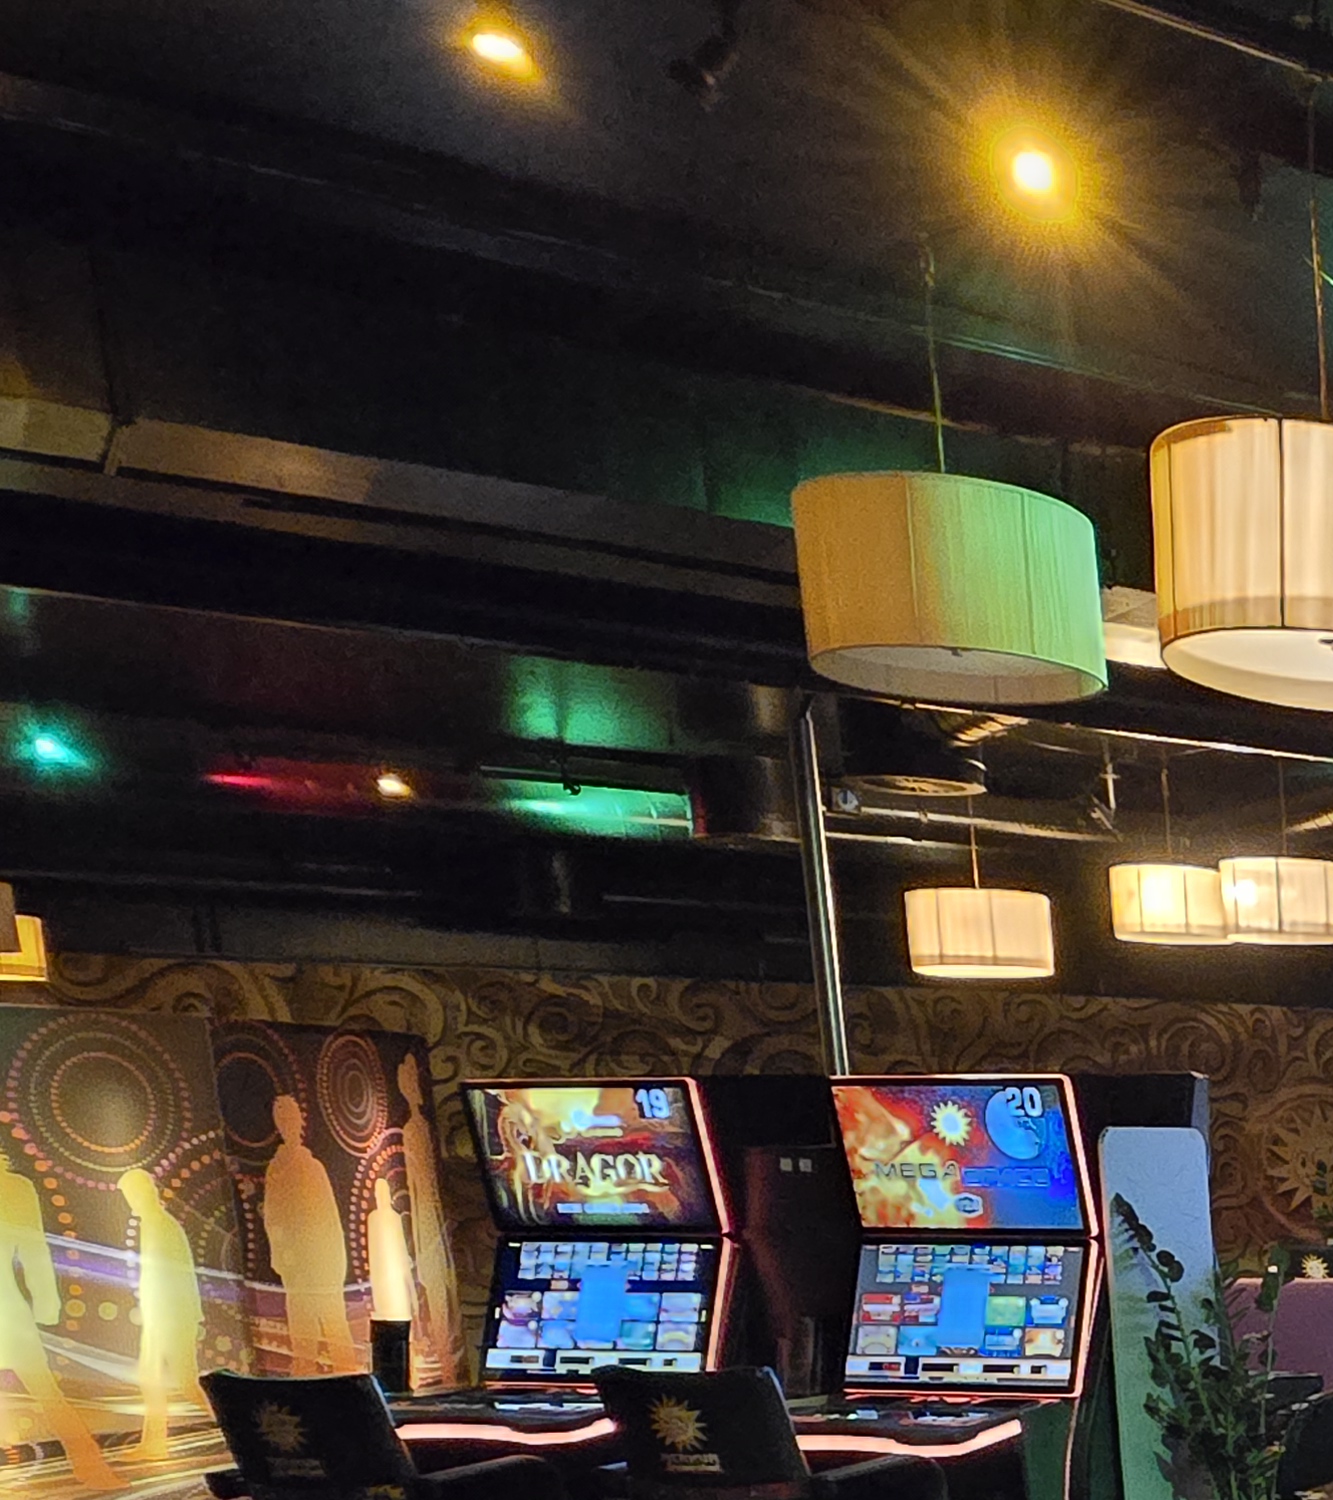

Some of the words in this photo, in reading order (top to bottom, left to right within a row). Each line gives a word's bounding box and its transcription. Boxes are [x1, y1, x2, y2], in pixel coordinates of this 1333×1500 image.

[636, 1088, 670, 1119] 19
[1005, 1086, 1043, 1118] 20
[523, 1150, 670, 1188] DRAGOR
[874, 1161, 961, 1181] MEGA
